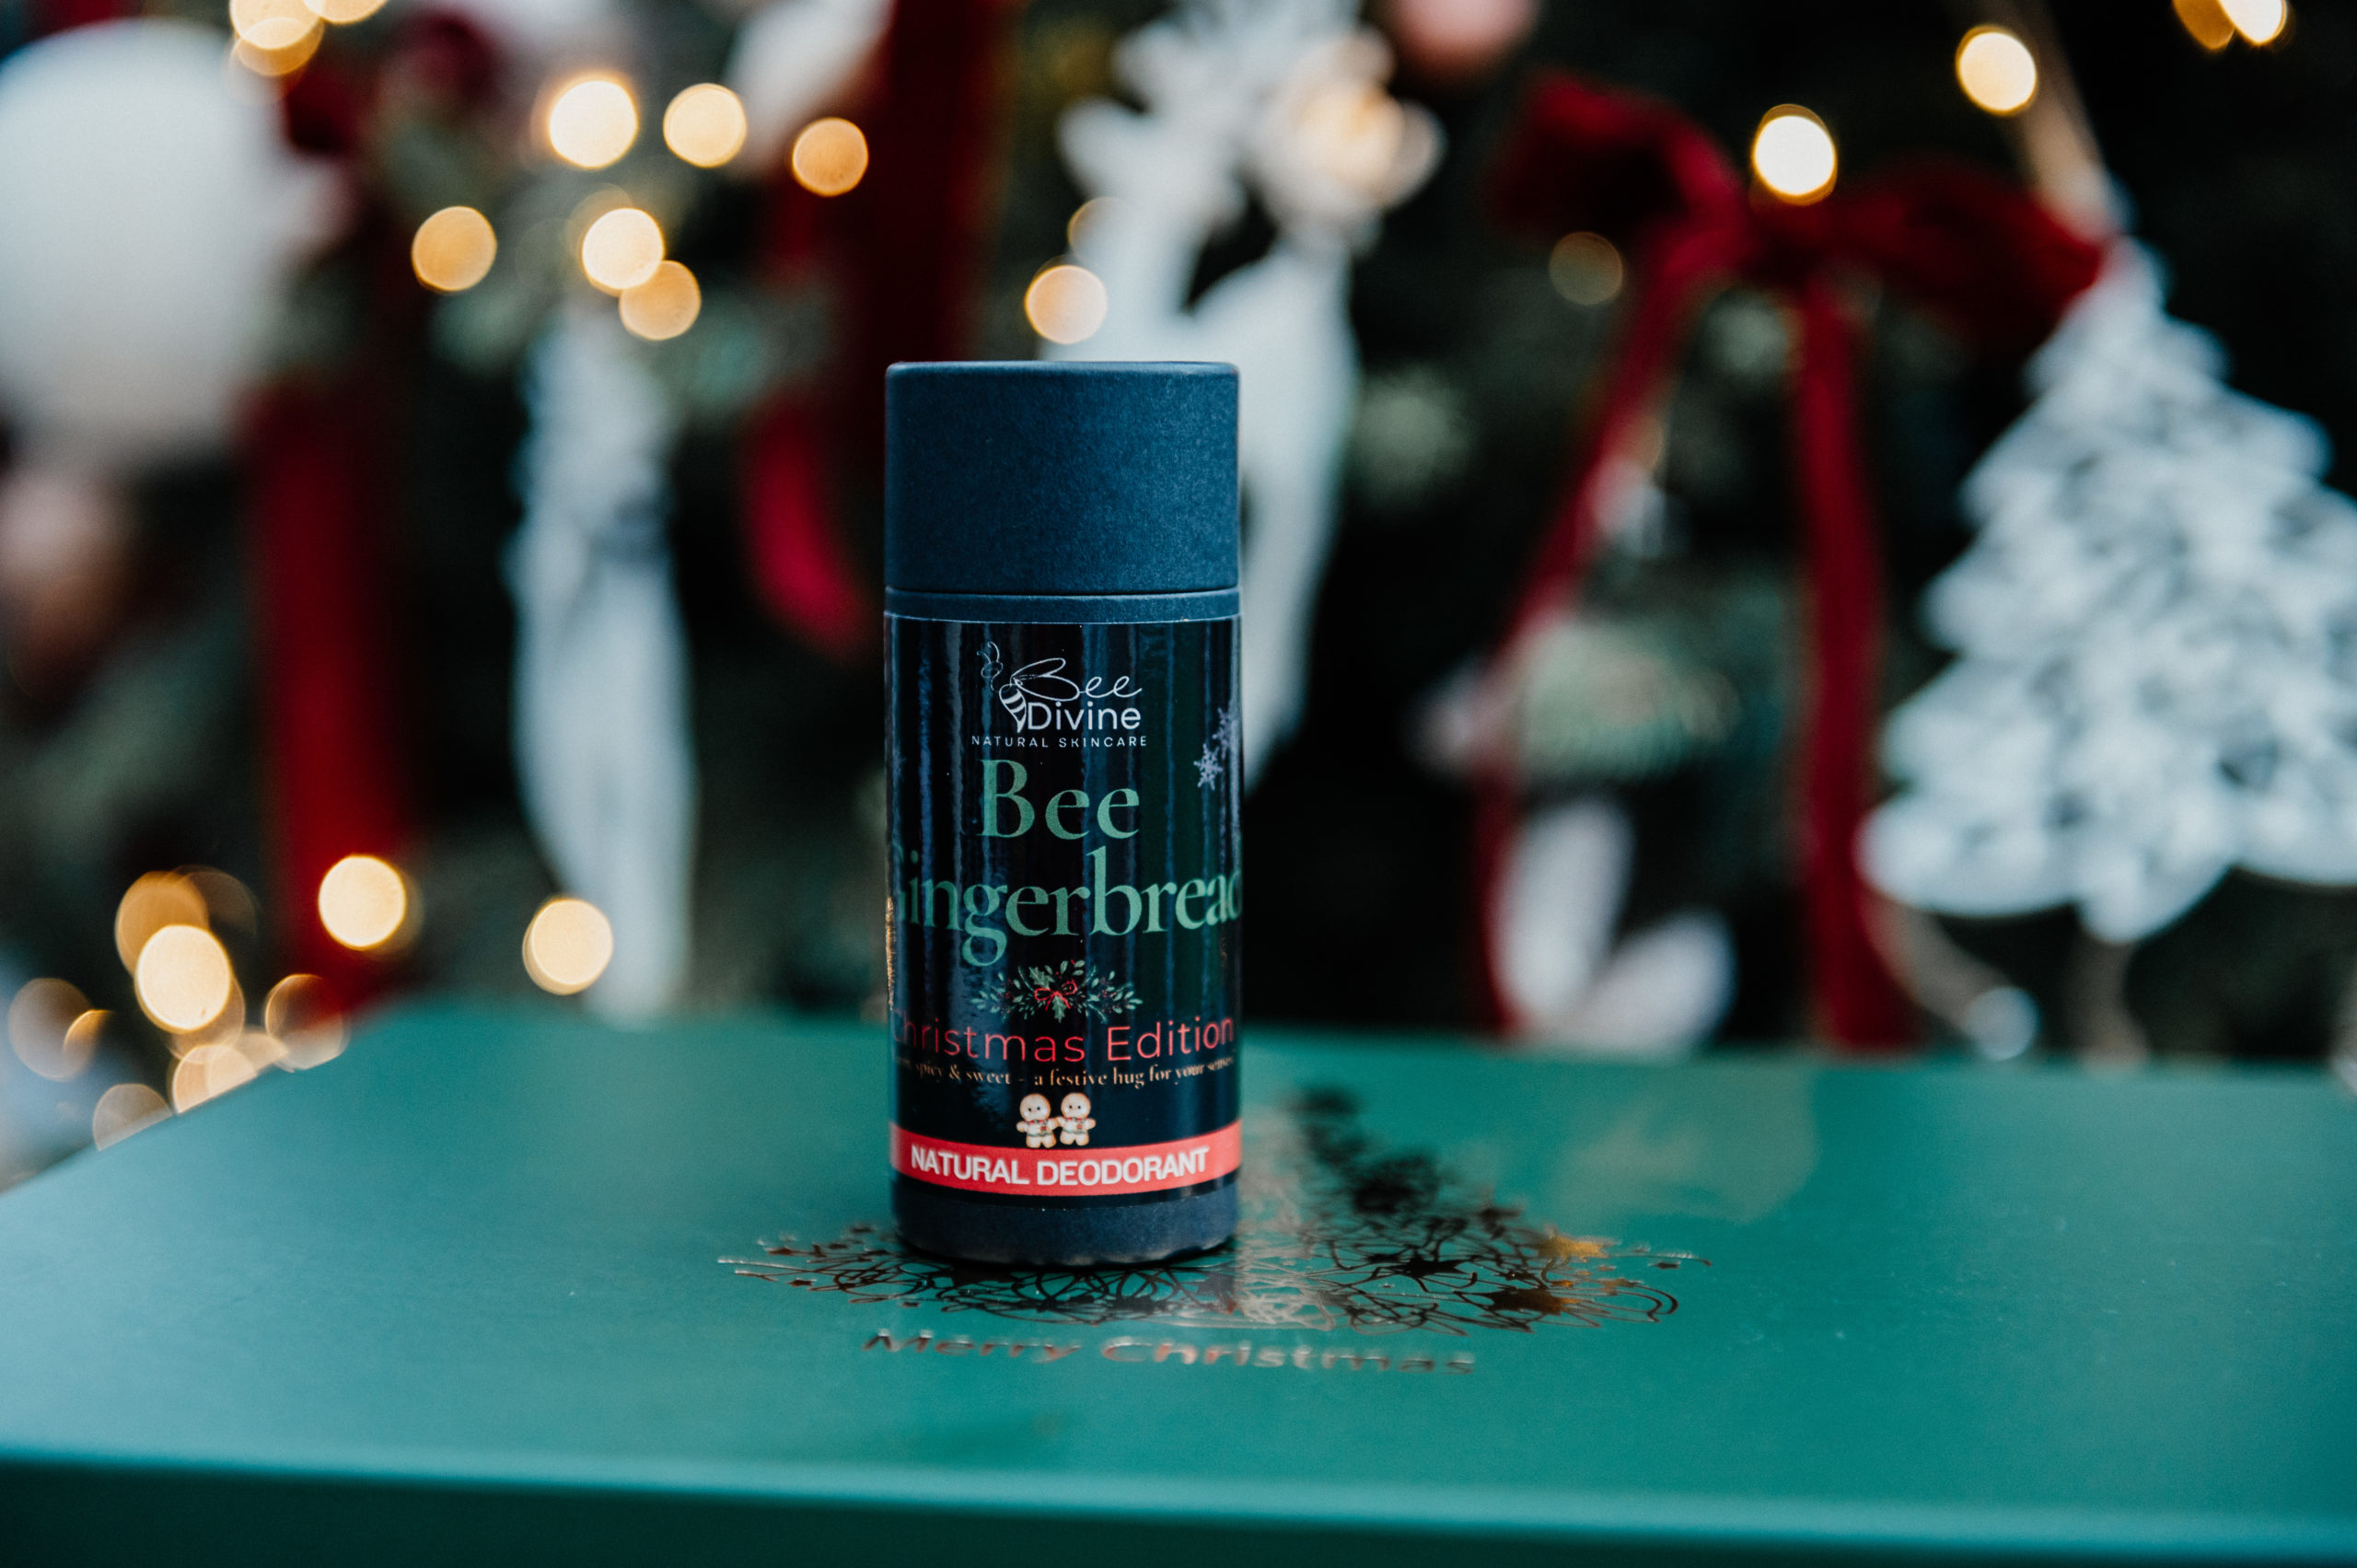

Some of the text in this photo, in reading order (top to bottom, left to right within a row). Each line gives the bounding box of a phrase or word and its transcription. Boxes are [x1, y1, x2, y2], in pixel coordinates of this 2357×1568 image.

[1010, 657, 1143, 702] Bee
[1027, 701, 1142, 730] Divine
[971, 736, 1147, 748] NATURAL SKINCARE
[976, 759, 1140, 840] Bee
[1108, 1016, 1233, 1062] Edition
[949, 1063, 960, 1080] &
[966, 1071, 1011, 1085] sweet
[1034, 1075, 1043, 1086] a
[1051, 1068, 1108, 1086] festive
[1113, 1066, 1144, 1089] hug
[1149, 1063, 1171, 1082] for
[911, 1144, 1210, 1186] NATURAL DEODORANT
[862, 1329, 1474, 1375] Merry Christmas
